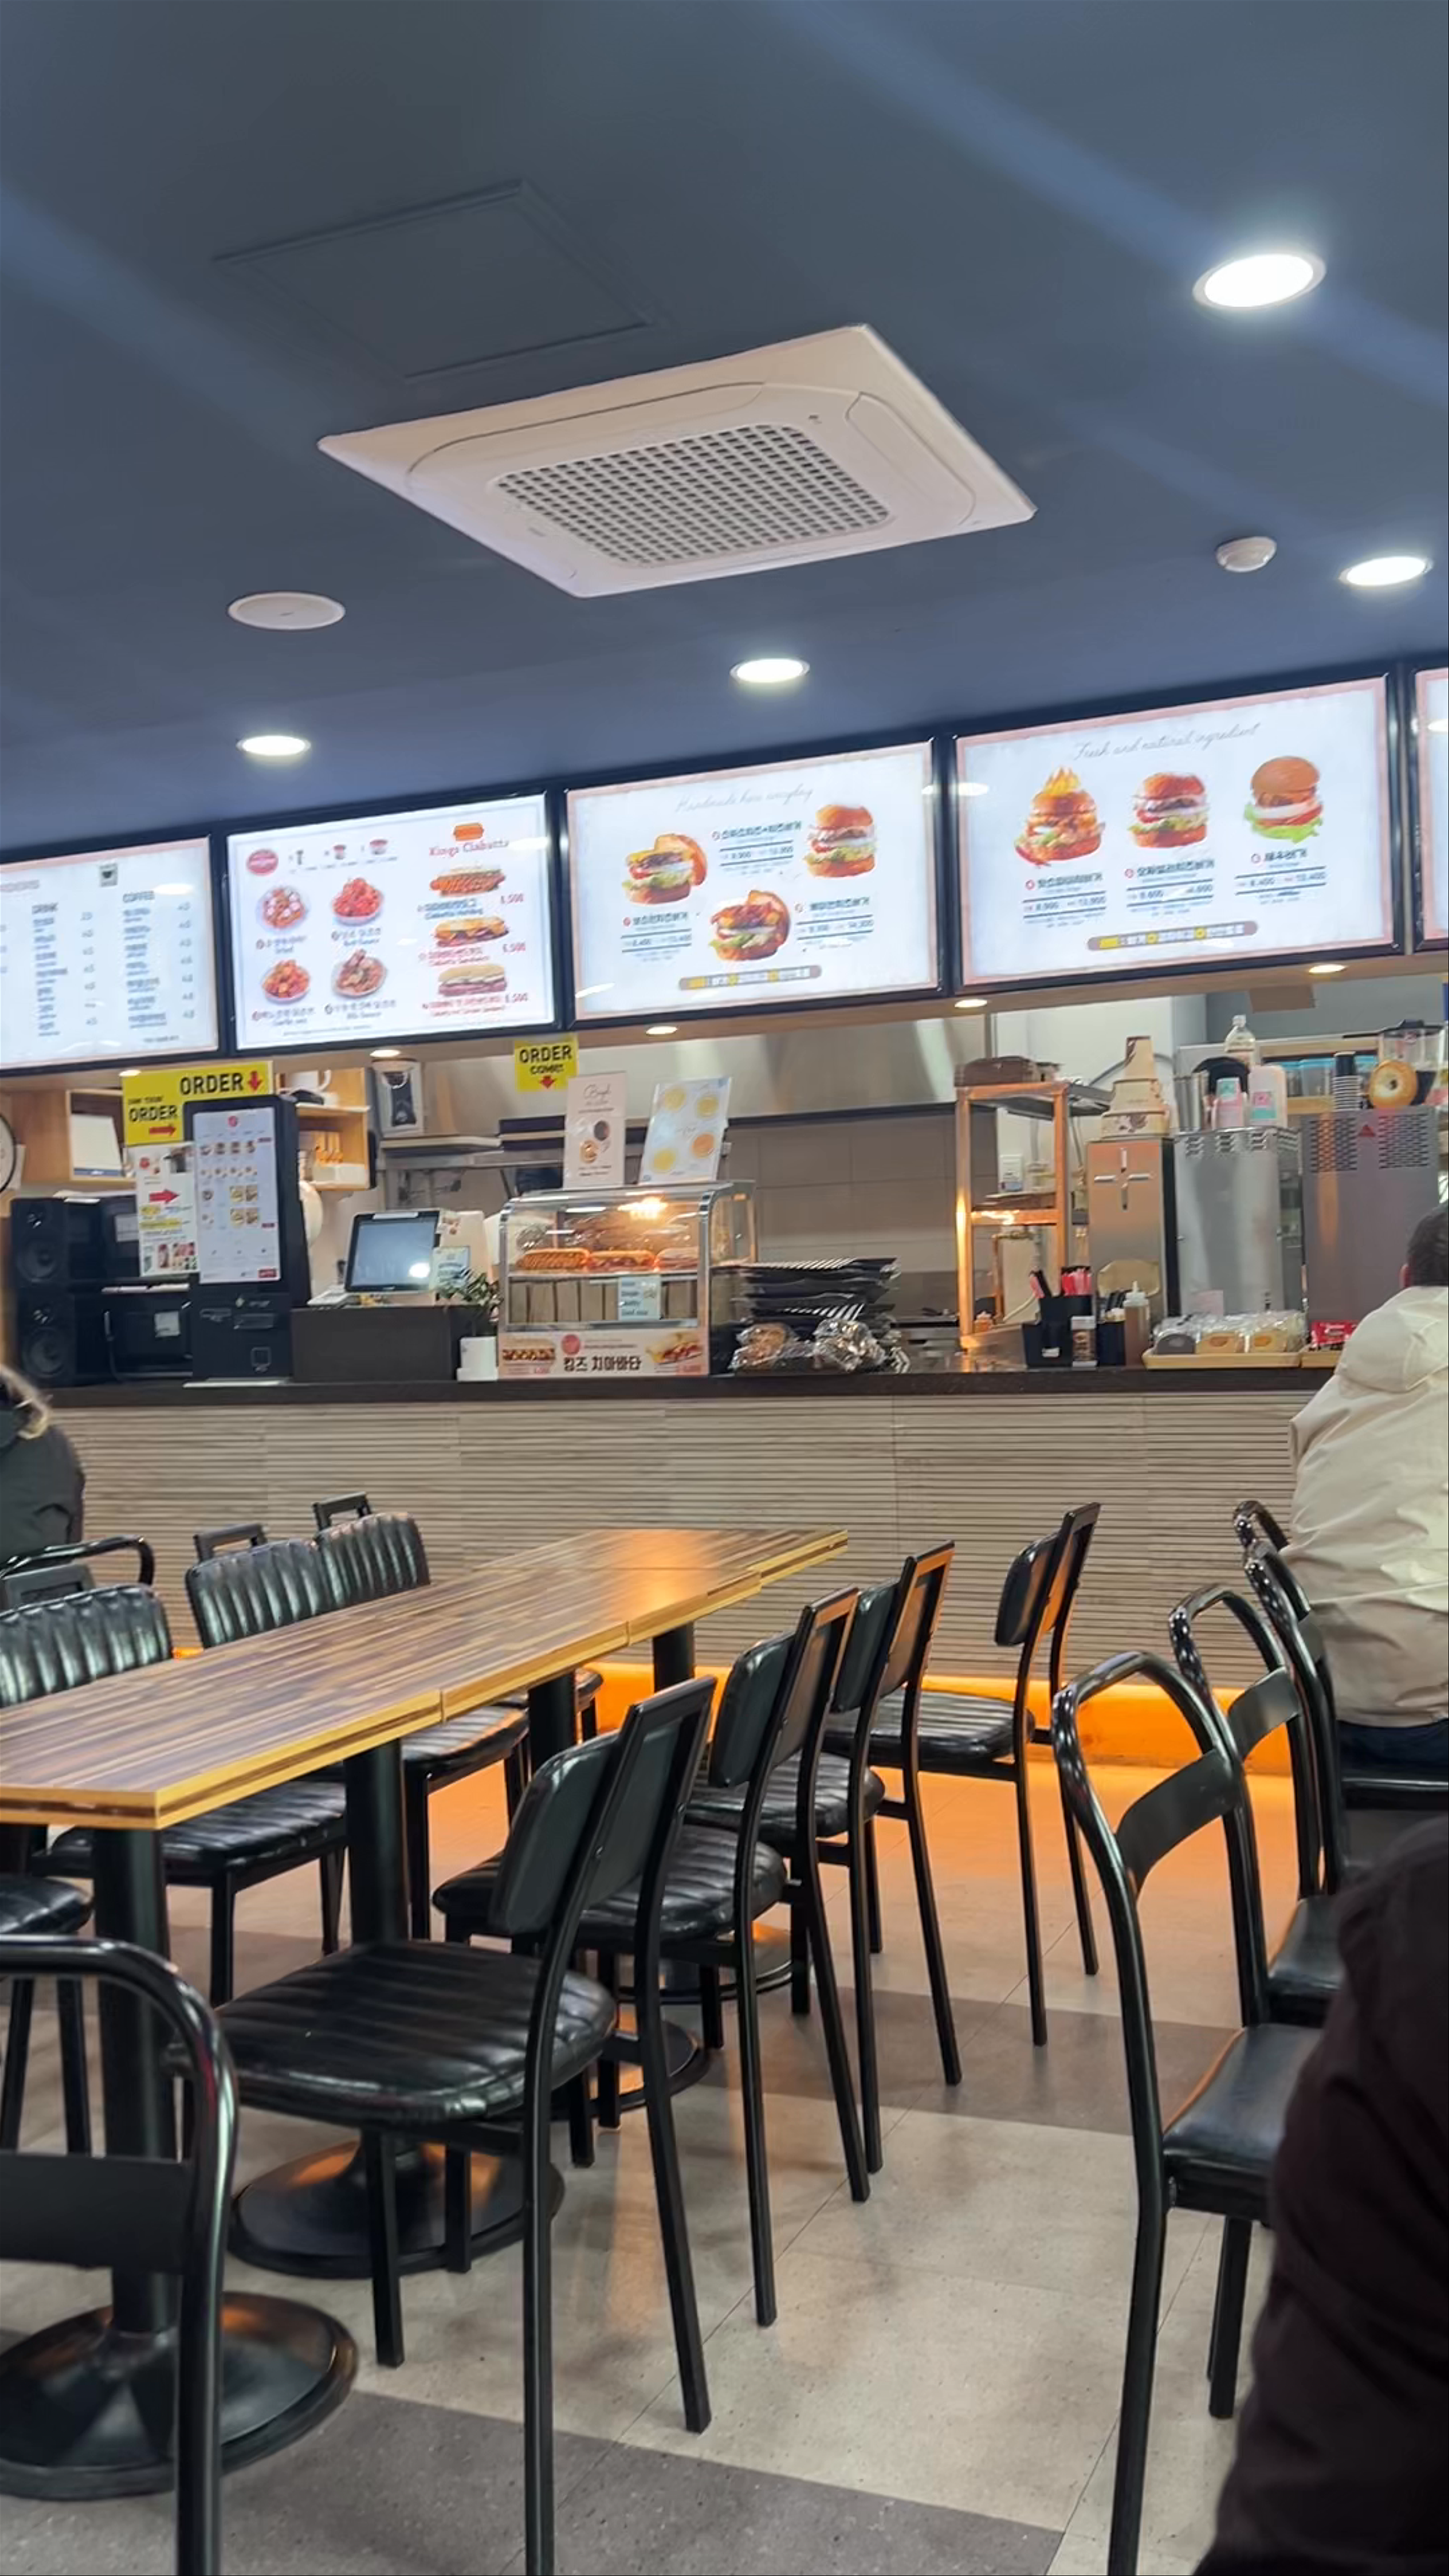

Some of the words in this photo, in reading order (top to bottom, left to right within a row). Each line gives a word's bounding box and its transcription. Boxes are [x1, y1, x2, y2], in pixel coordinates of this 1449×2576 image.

[520, 1045, 572, 1063] ORDER
[180, 1072, 244, 1095] ORDER
[129, 1105, 177, 1122] ORDER
[564, 1356, 588, 1372] 킹즈
[591, 1355, 642, 1371] 치아바타
